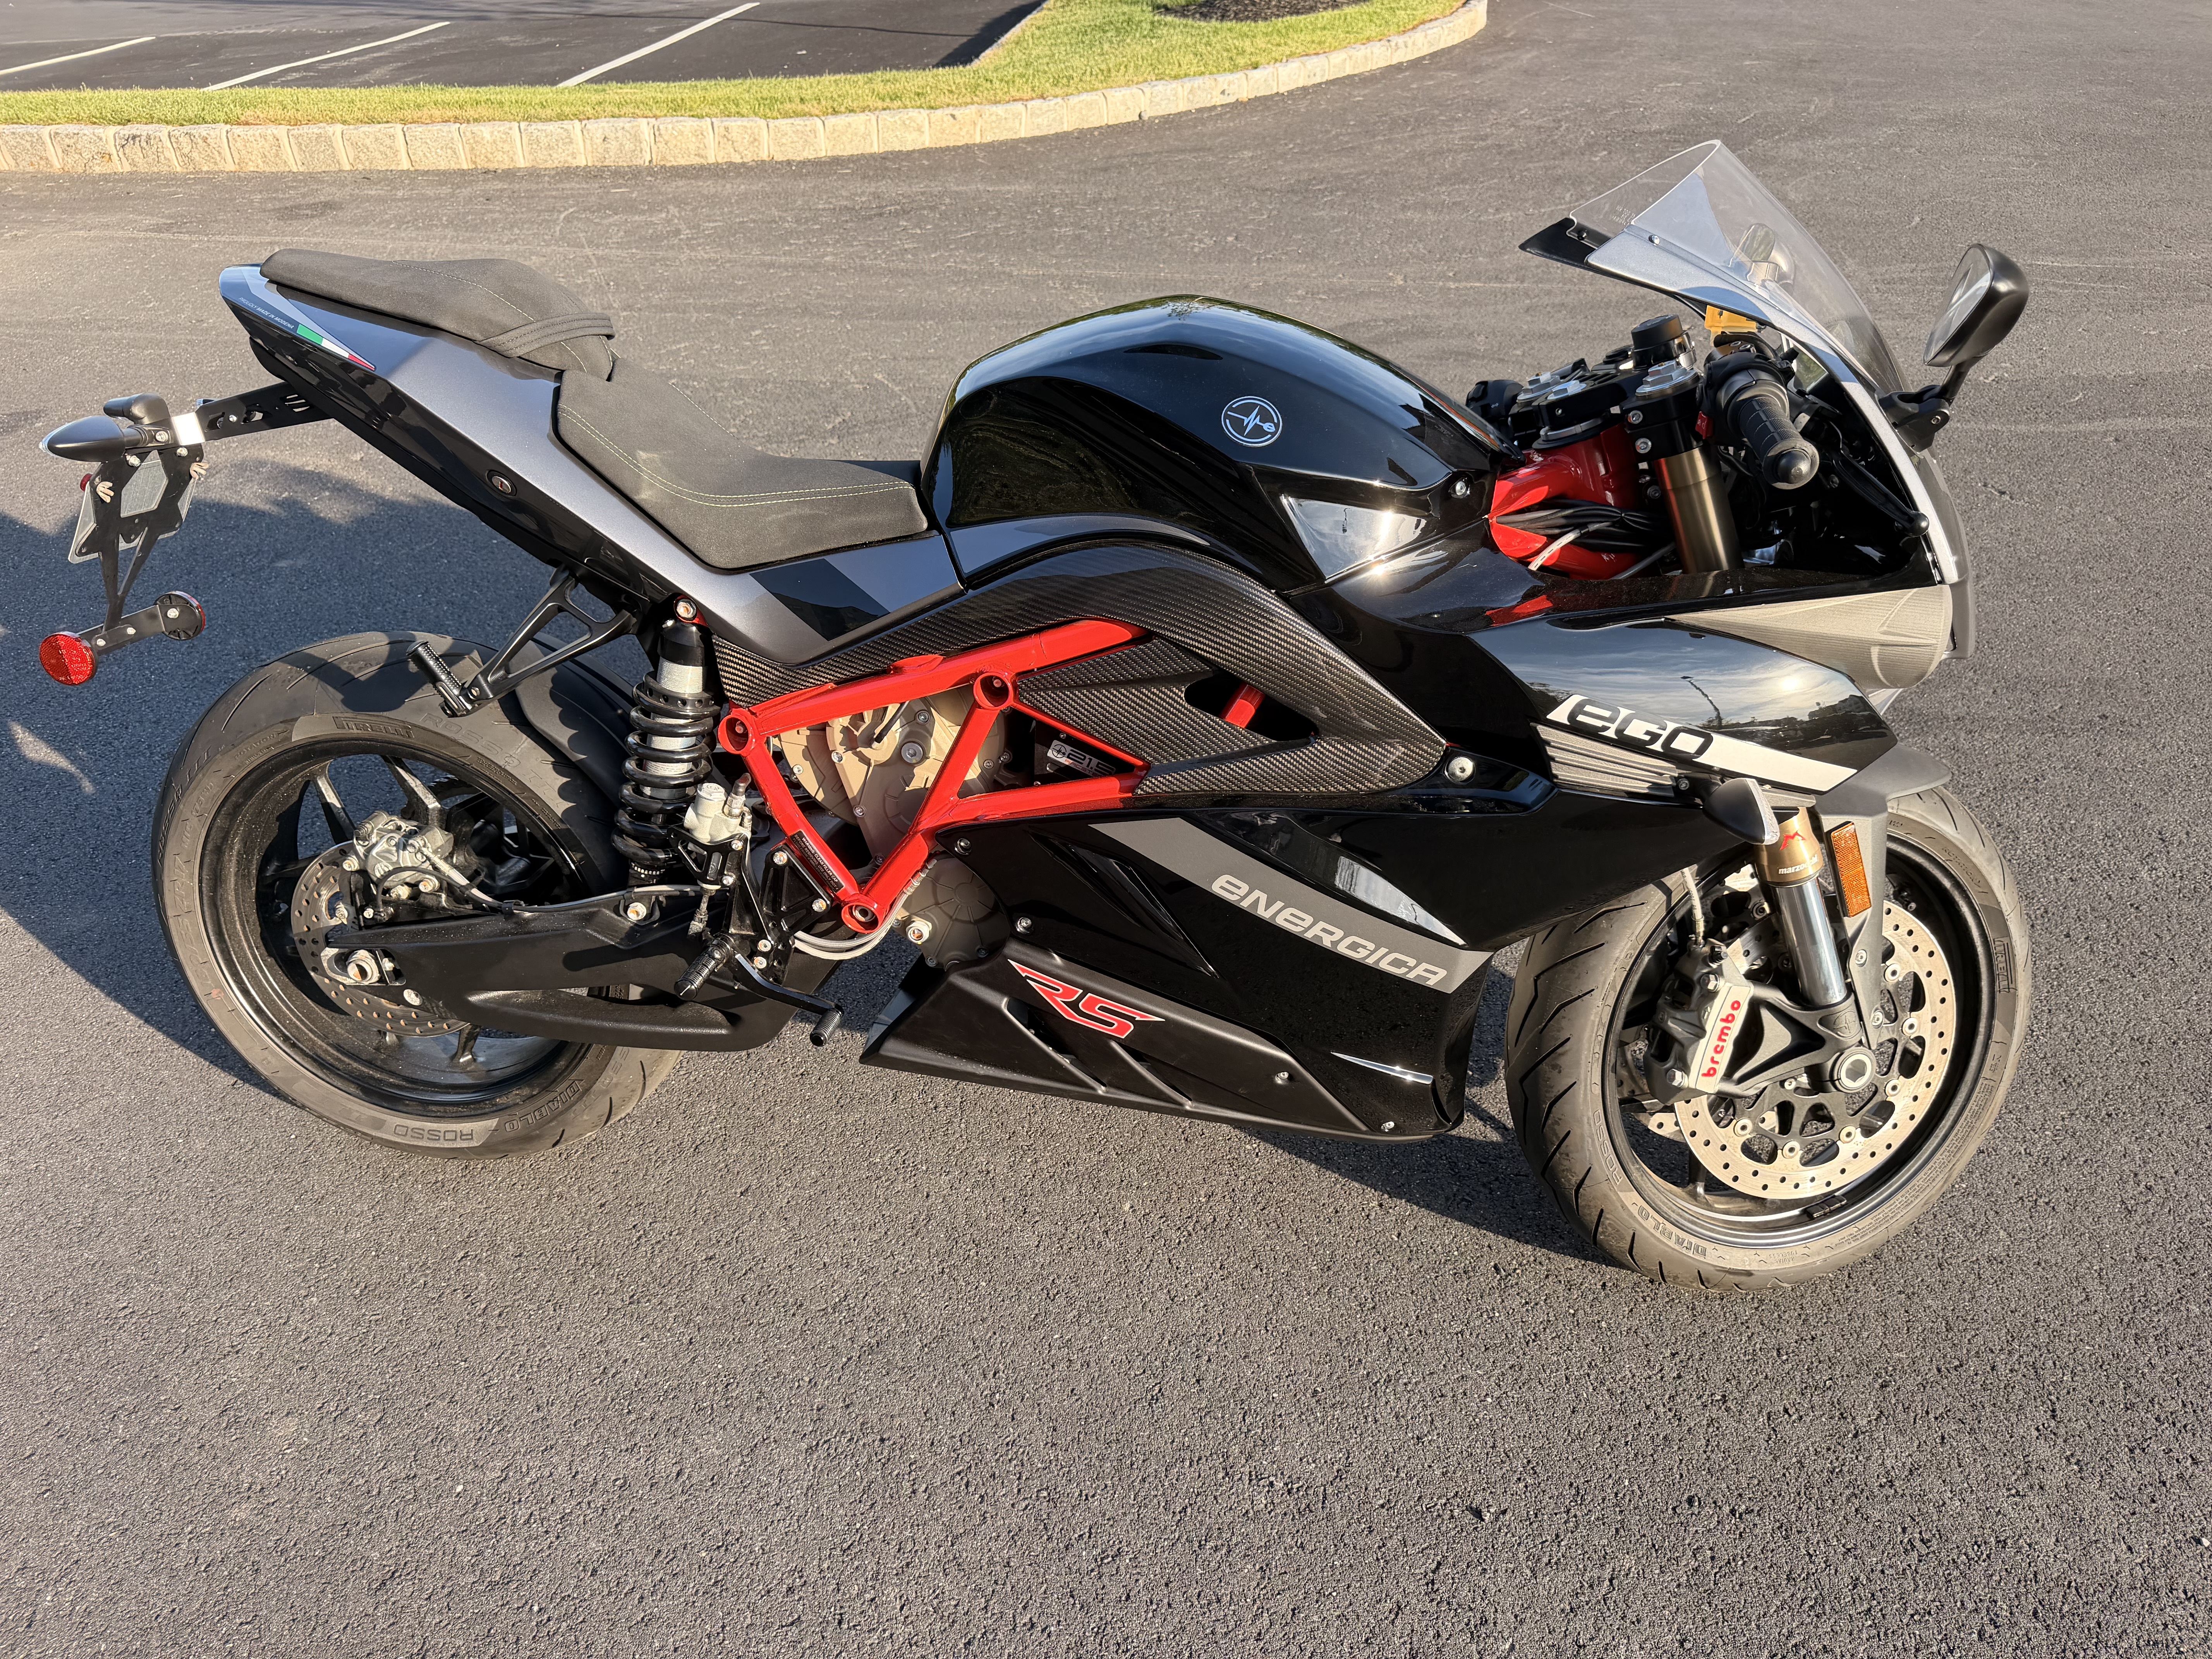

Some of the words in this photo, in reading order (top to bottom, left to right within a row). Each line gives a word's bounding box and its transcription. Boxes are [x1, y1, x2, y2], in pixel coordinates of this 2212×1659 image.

[256, 307, 270, 316] MADE
[274, 317, 294, 329] MODENA
[1066, 749, 1116, 775] 21.5
[1008, 959, 1165, 1039] RS
[393, 1124, 474, 1141] ROSSO
[504, 1080, 582, 1133] DIABLO
[1593, 1109, 1623, 1186] ROSSO
[1637, 1204, 1707, 1259] DIABLO
